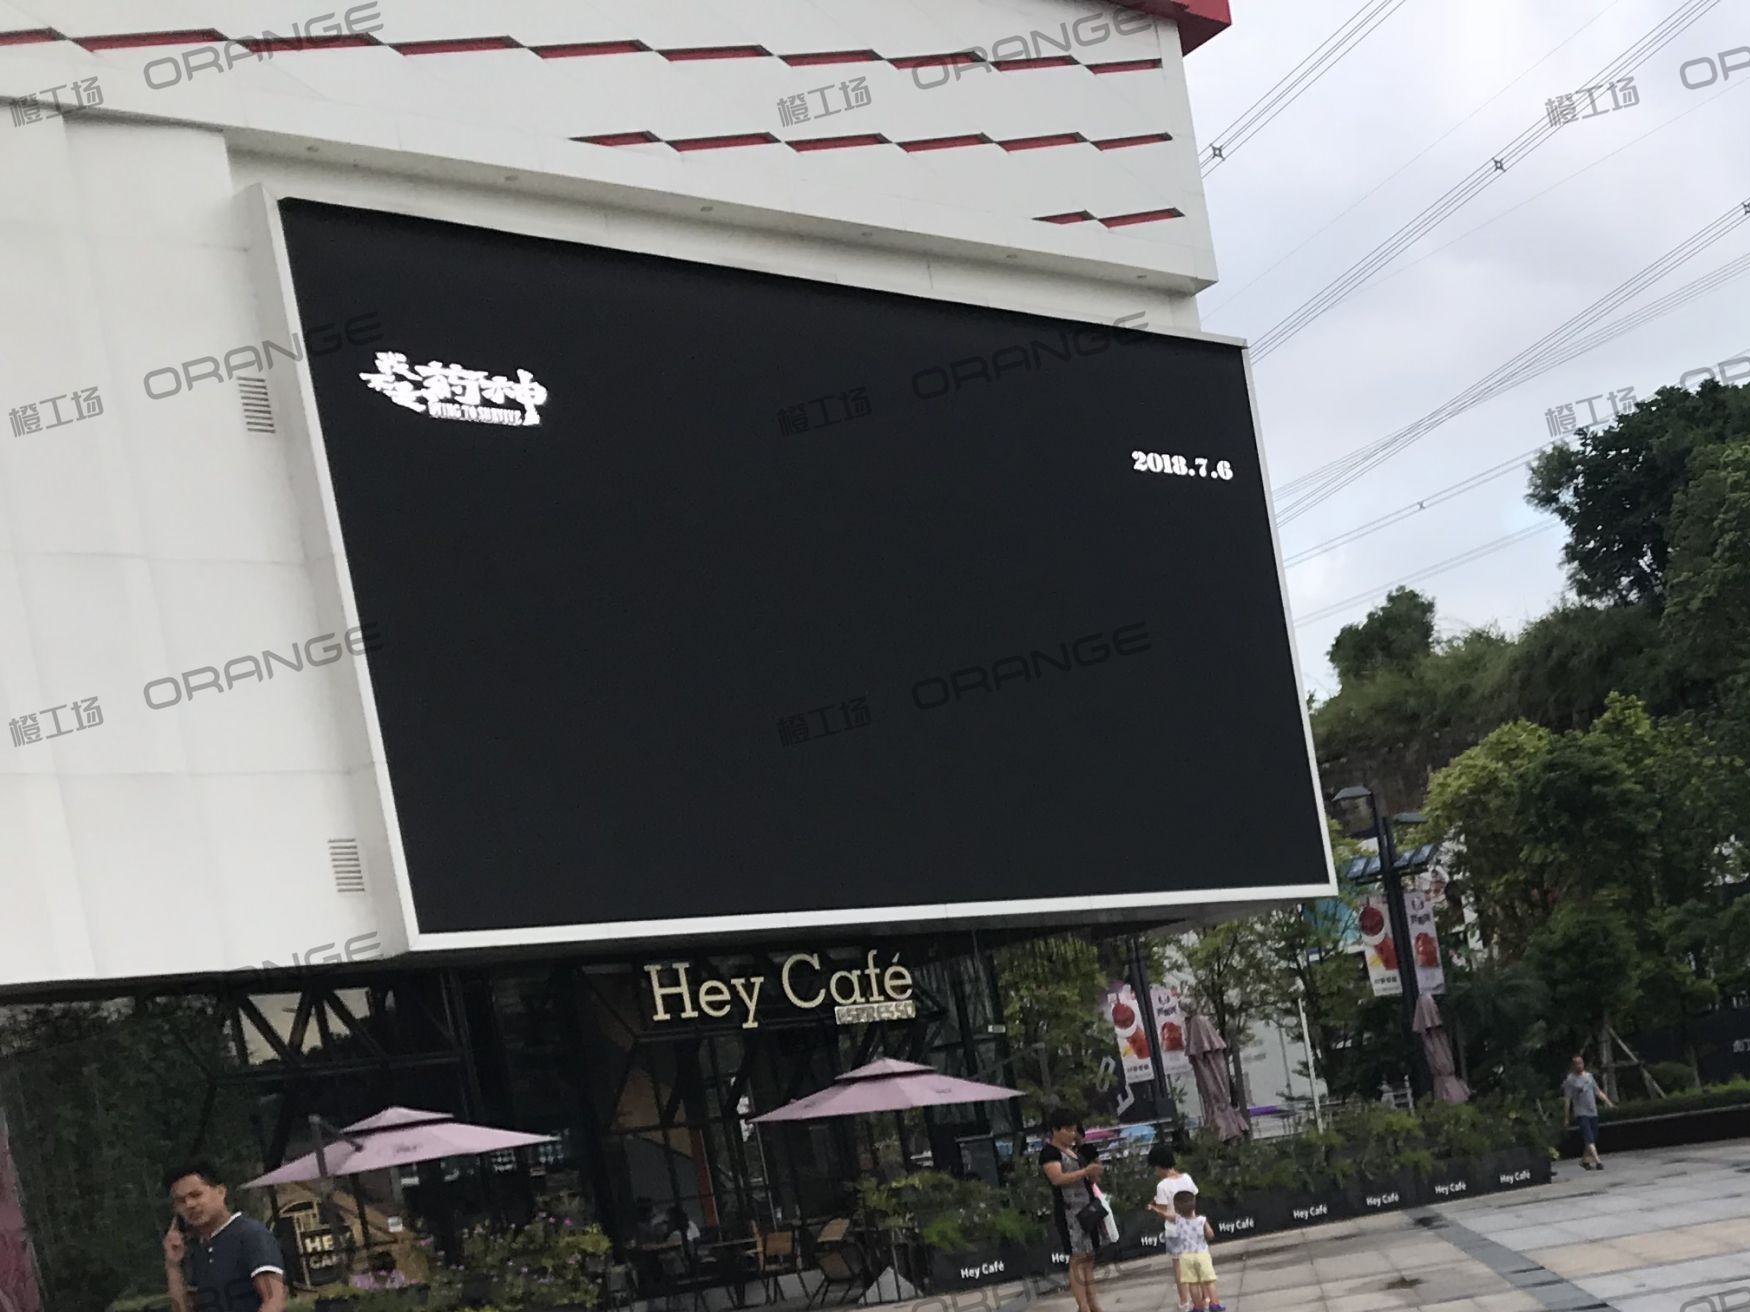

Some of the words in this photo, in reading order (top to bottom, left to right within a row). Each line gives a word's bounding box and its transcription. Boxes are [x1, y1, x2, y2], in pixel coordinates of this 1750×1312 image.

[1131, 450, 1233, 480] 2018.7.6
[644, 962, 764, 1028] Hey
[782, 950, 912, 1009] Café
[837, 1002, 915, 1024] ESPRESSO
[1293, 1208, 1308, 1220] Hey
[1219, 1222, 1235, 1234] Hey
[1051, 1252, 1070, 1266] Hey
[960, 1267, 980, 1280] Hey
[982, 1261, 1005, 1274] Café
